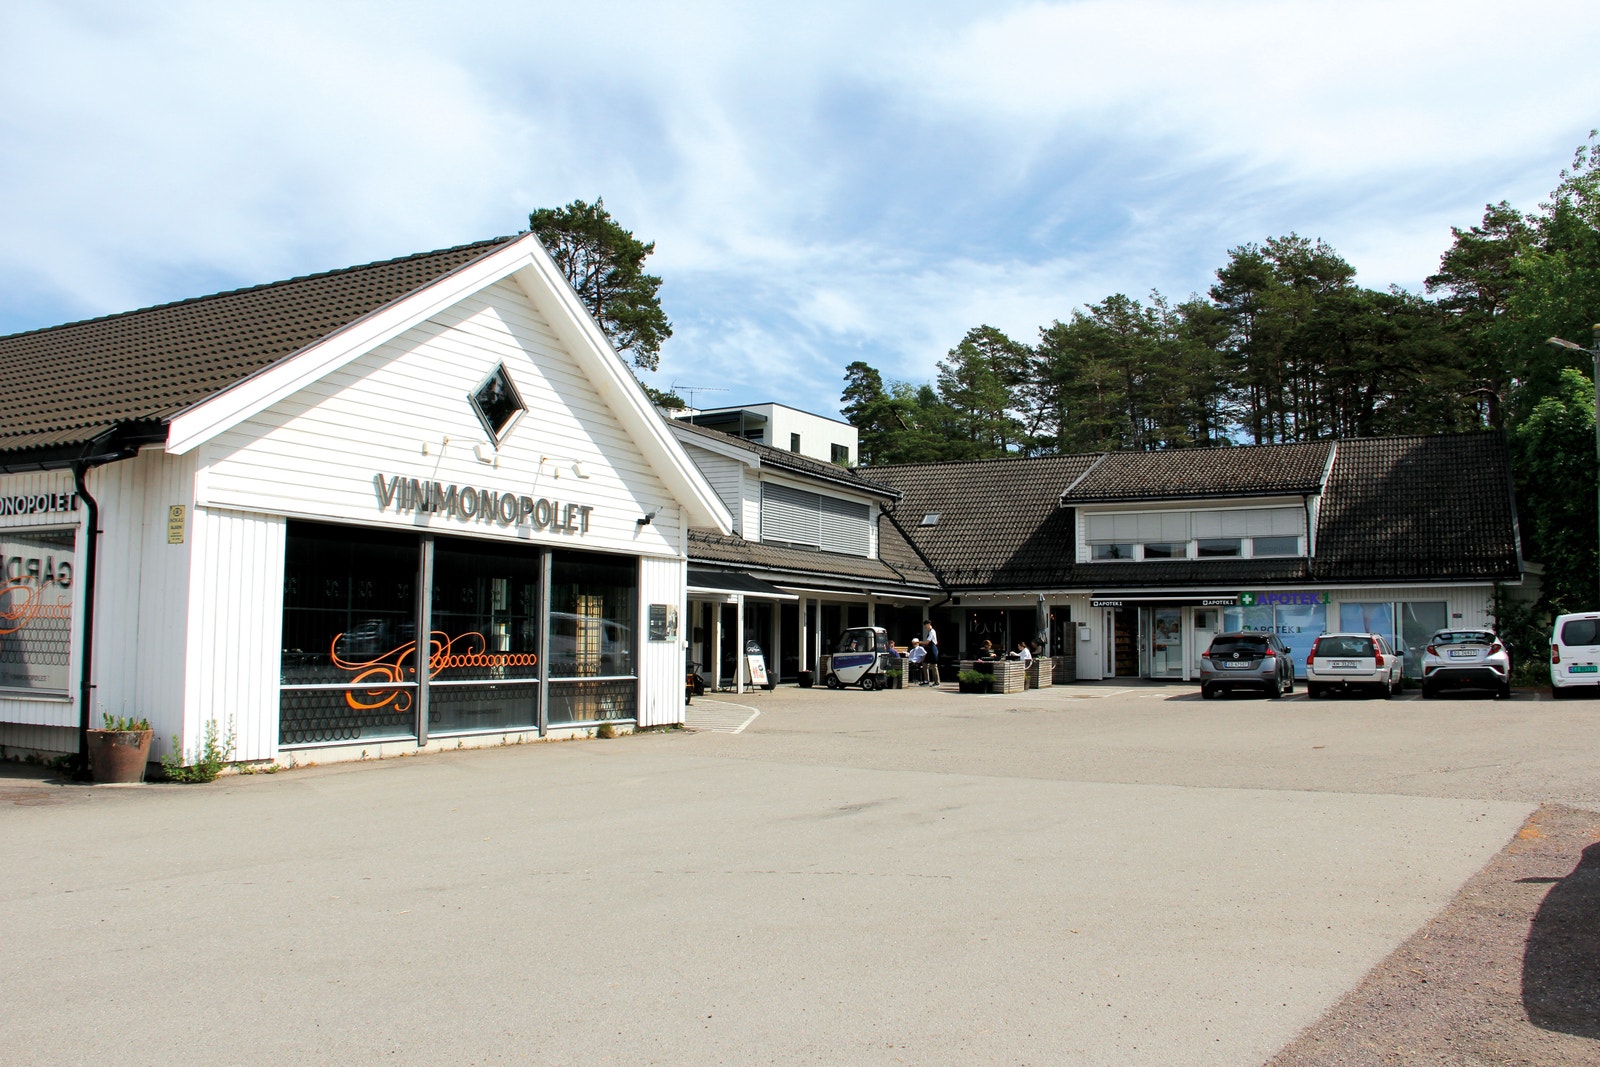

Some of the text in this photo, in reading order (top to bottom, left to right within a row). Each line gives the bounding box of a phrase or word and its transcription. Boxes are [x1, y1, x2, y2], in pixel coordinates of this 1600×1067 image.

[374, 473, 594, 533] VINMONOPOLET
[1256, 592, 1331, 605] APOTEK 1
